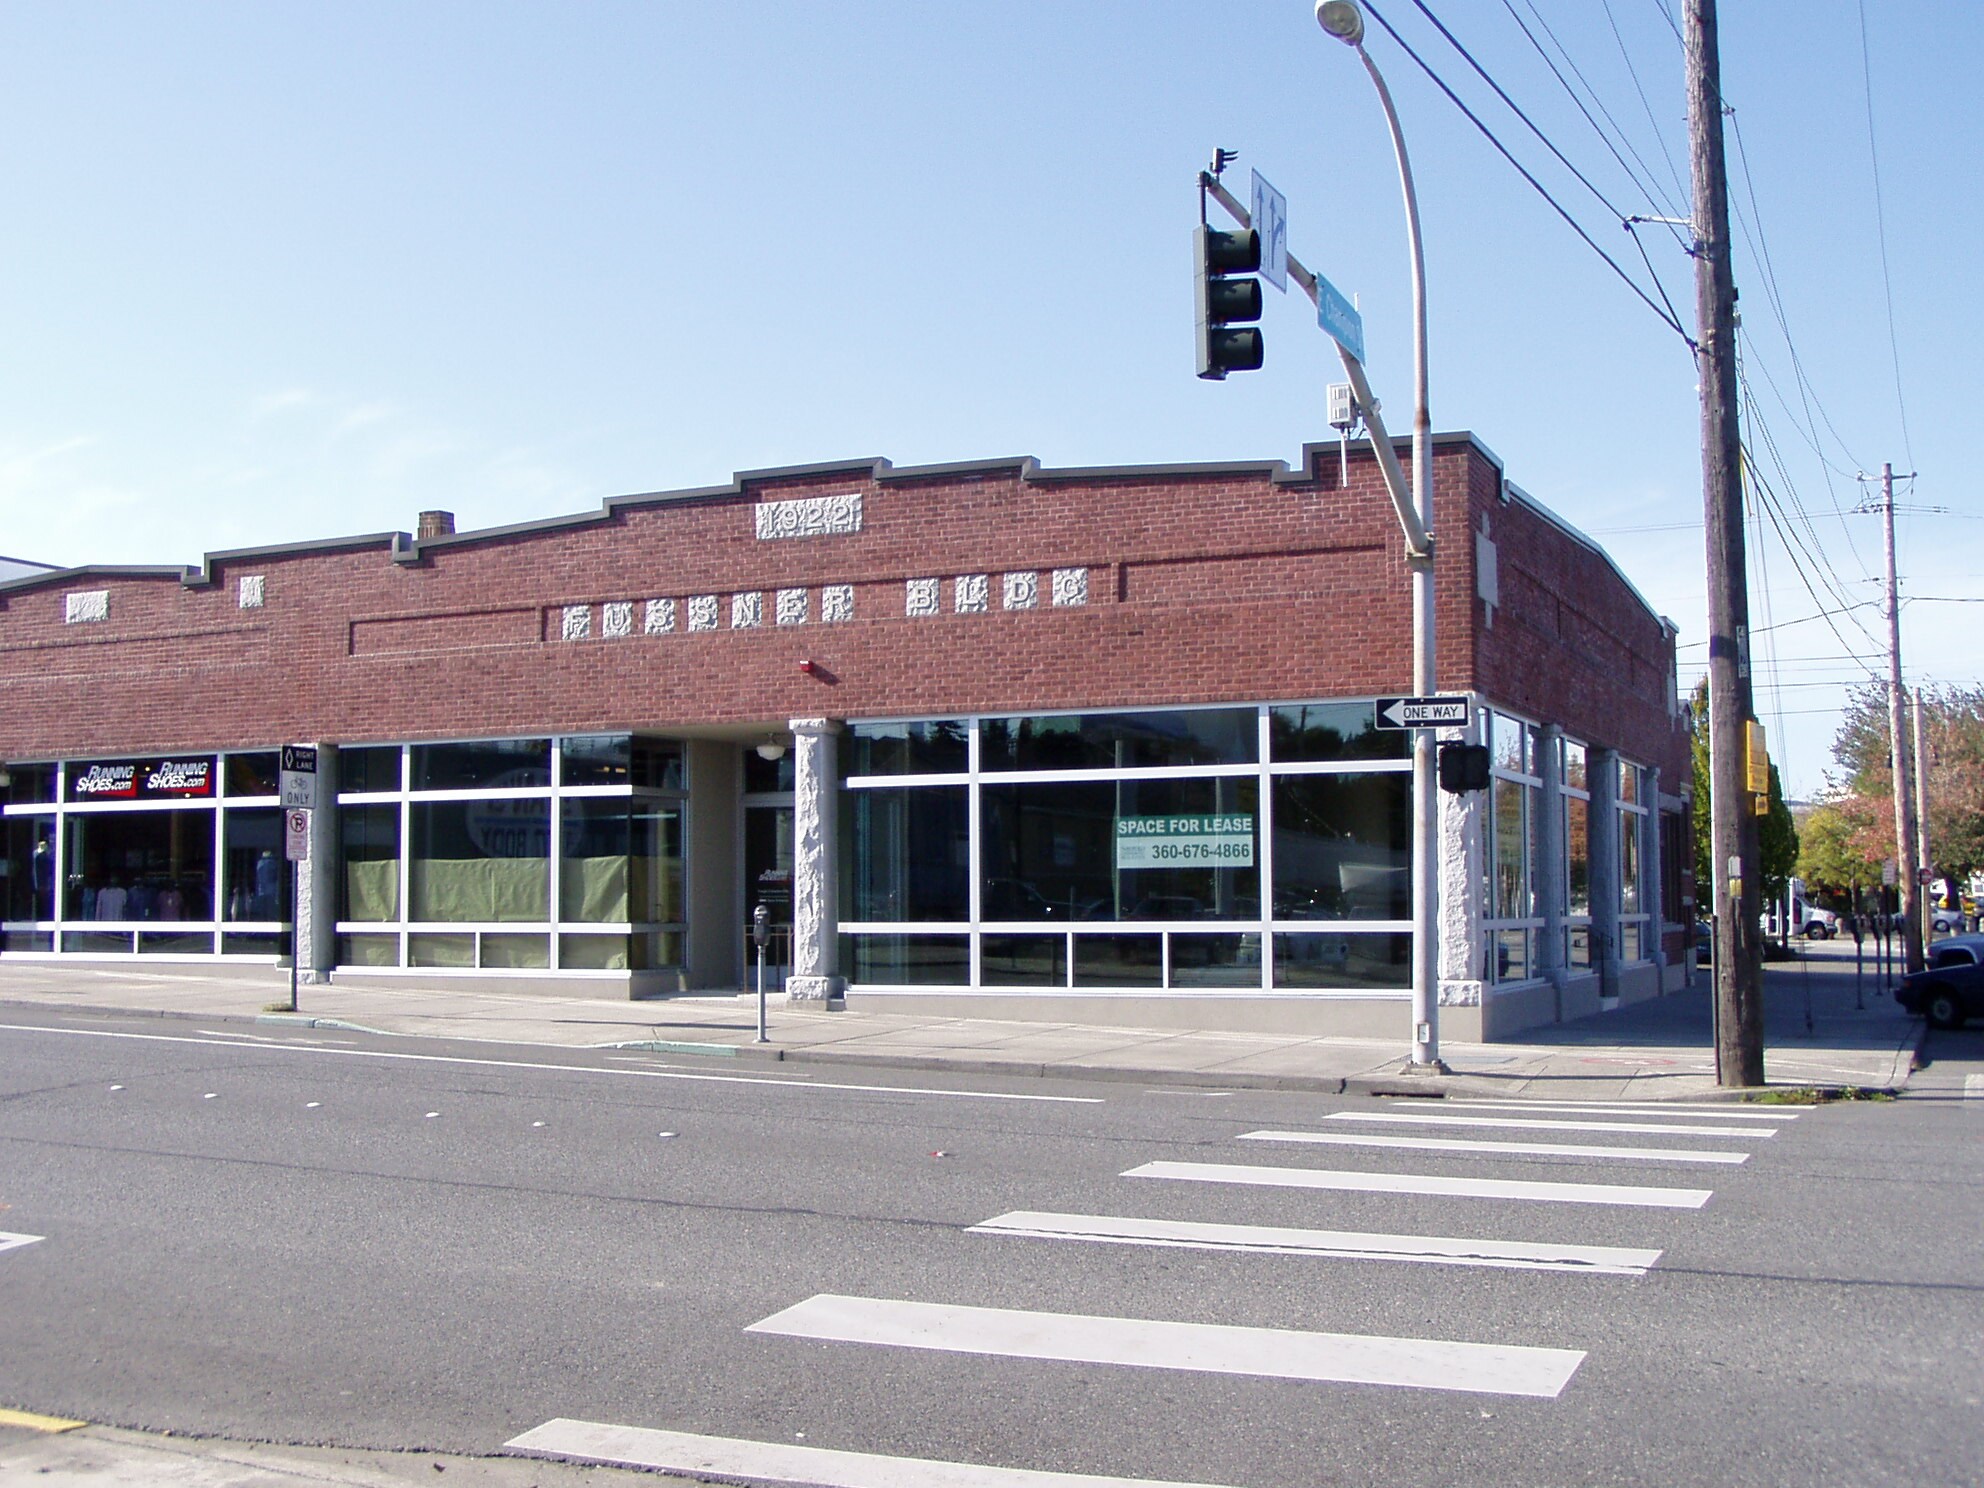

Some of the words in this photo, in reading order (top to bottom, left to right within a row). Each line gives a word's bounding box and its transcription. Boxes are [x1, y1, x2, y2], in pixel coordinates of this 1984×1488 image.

[765, 503, 851, 532] 1922
[567, 591, 849, 635] FUSSNER
[910, 575, 1081, 609] BLDG
[1403, 706, 1428, 719] ONE
[1432, 705, 1458, 718] WAY
[296, 750, 315, 760] RIGHT
[88, 765, 136, 780] RUNNING
[159, 761, 209, 776] RUNNING
[296, 761, 314, 770] LANE
[287, 792, 310, 804] ONLY
[1118, 819, 1166, 834] SPACE
[1169, 818, 1200, 833] FOR
[1203, 817, 1253, 832] LEASE
[1151, 843, 1250, 859] 360-676-4866
